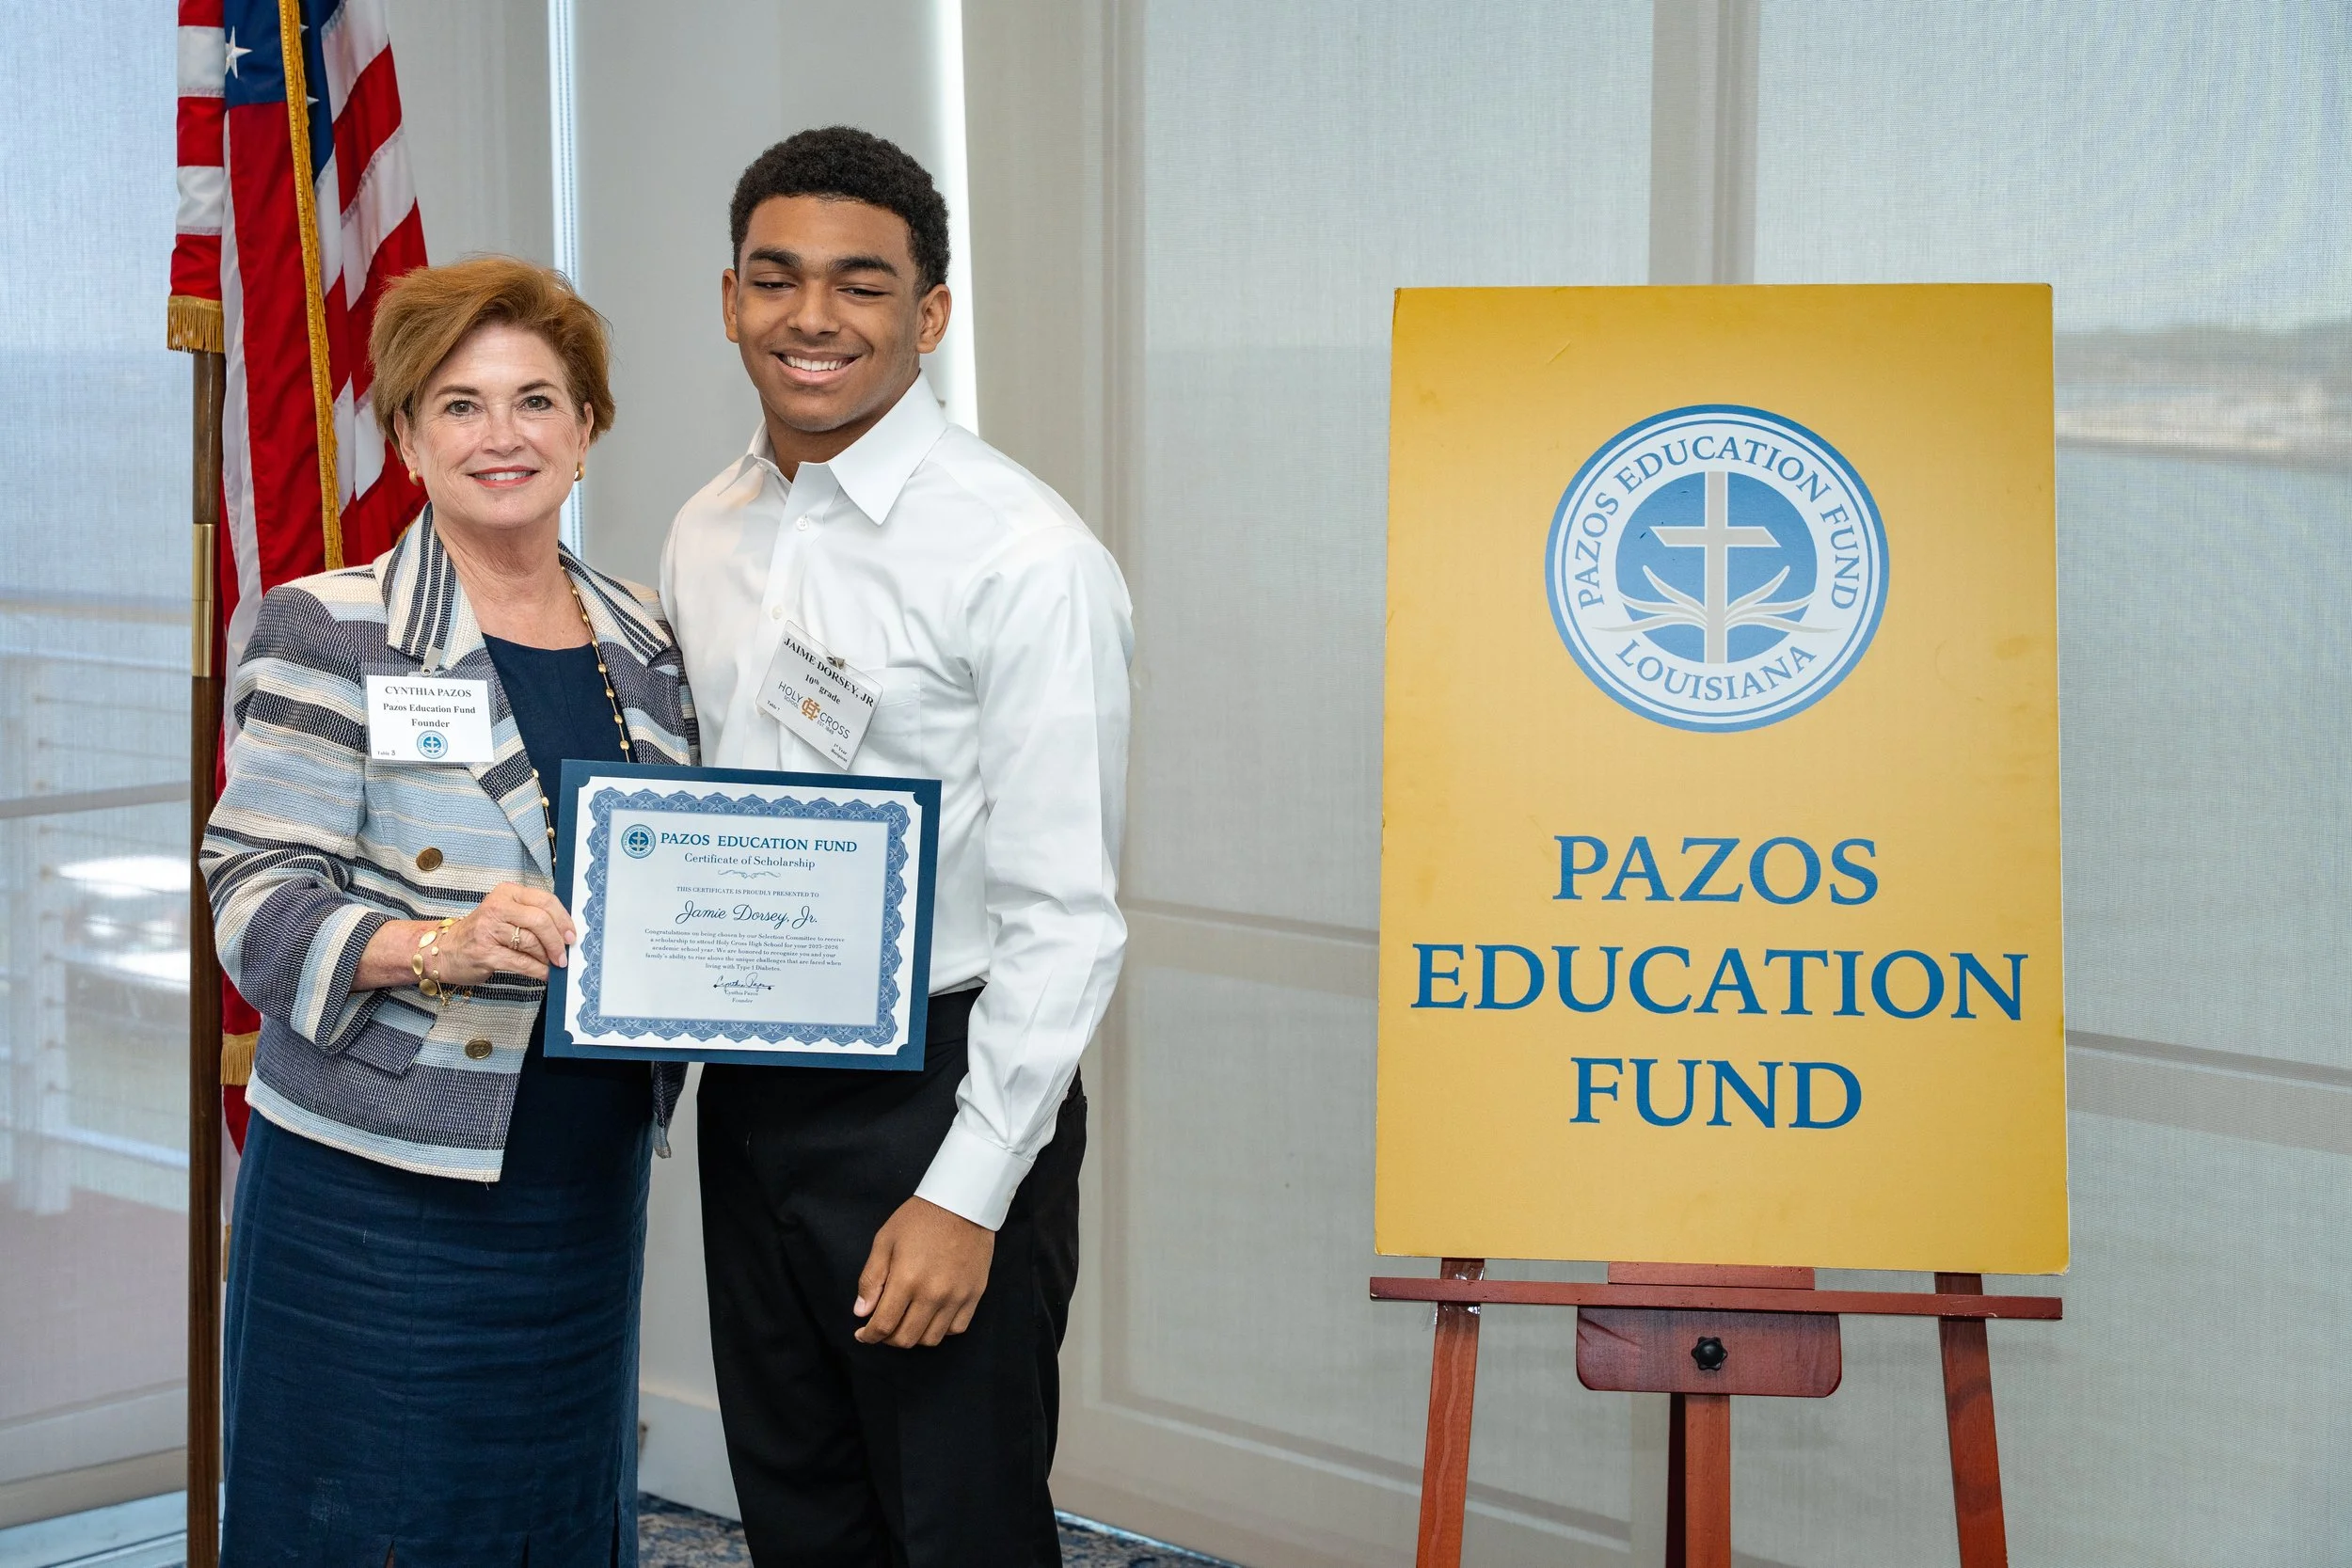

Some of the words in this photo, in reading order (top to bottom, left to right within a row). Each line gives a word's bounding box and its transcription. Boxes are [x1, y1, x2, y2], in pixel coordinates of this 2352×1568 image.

[1575, 491, 1619, 610] PAZOS
[1613, 436, 1832, 502] EDUCATION
[1820, 504, 1860, 610] FUND
[385, 686, 436, 696] CYNTHIA
[437, 689, 472, 697] PAZOS
[784, 638, 816, 666] JAIME
[817, 661, 859, 698] DORSEY,
[860, 692, 875, 708] JR
[804, 673, 820, 686] 10th
[818, 686, 841, 705] grade
[1615, 640, 1817, 701] LOUISIANA
[383, 703, 407, 711] Pazos
[409, 704, 452, 713] Education
[453, 705, 476, 714] Fund
[411, 719, 451, 728] Founder
[778, 681, 803, 704] HOLY
[819, 712, 850, 739] CROSS
[660, 832, 710, 846] PAZOS
[718, 835, 808, 850] EDUCATION
[814, 840, 857, 852] FUND
[684, 852, 739, 864] Certificate
[740, 856, 752, 865] of
[753, 856, 816, 871] Scholarship
[1552, 834, 1879, 906] PAZOS
[675, 900, 727, 925] Jamie
[733, 904, 790, 929] Dorsey,
[791, 905, 818, 929] Jr.
[1410, 942, 2028, 1021] EDUCATION
[1569, 1056, 1862, 1130] FUND
